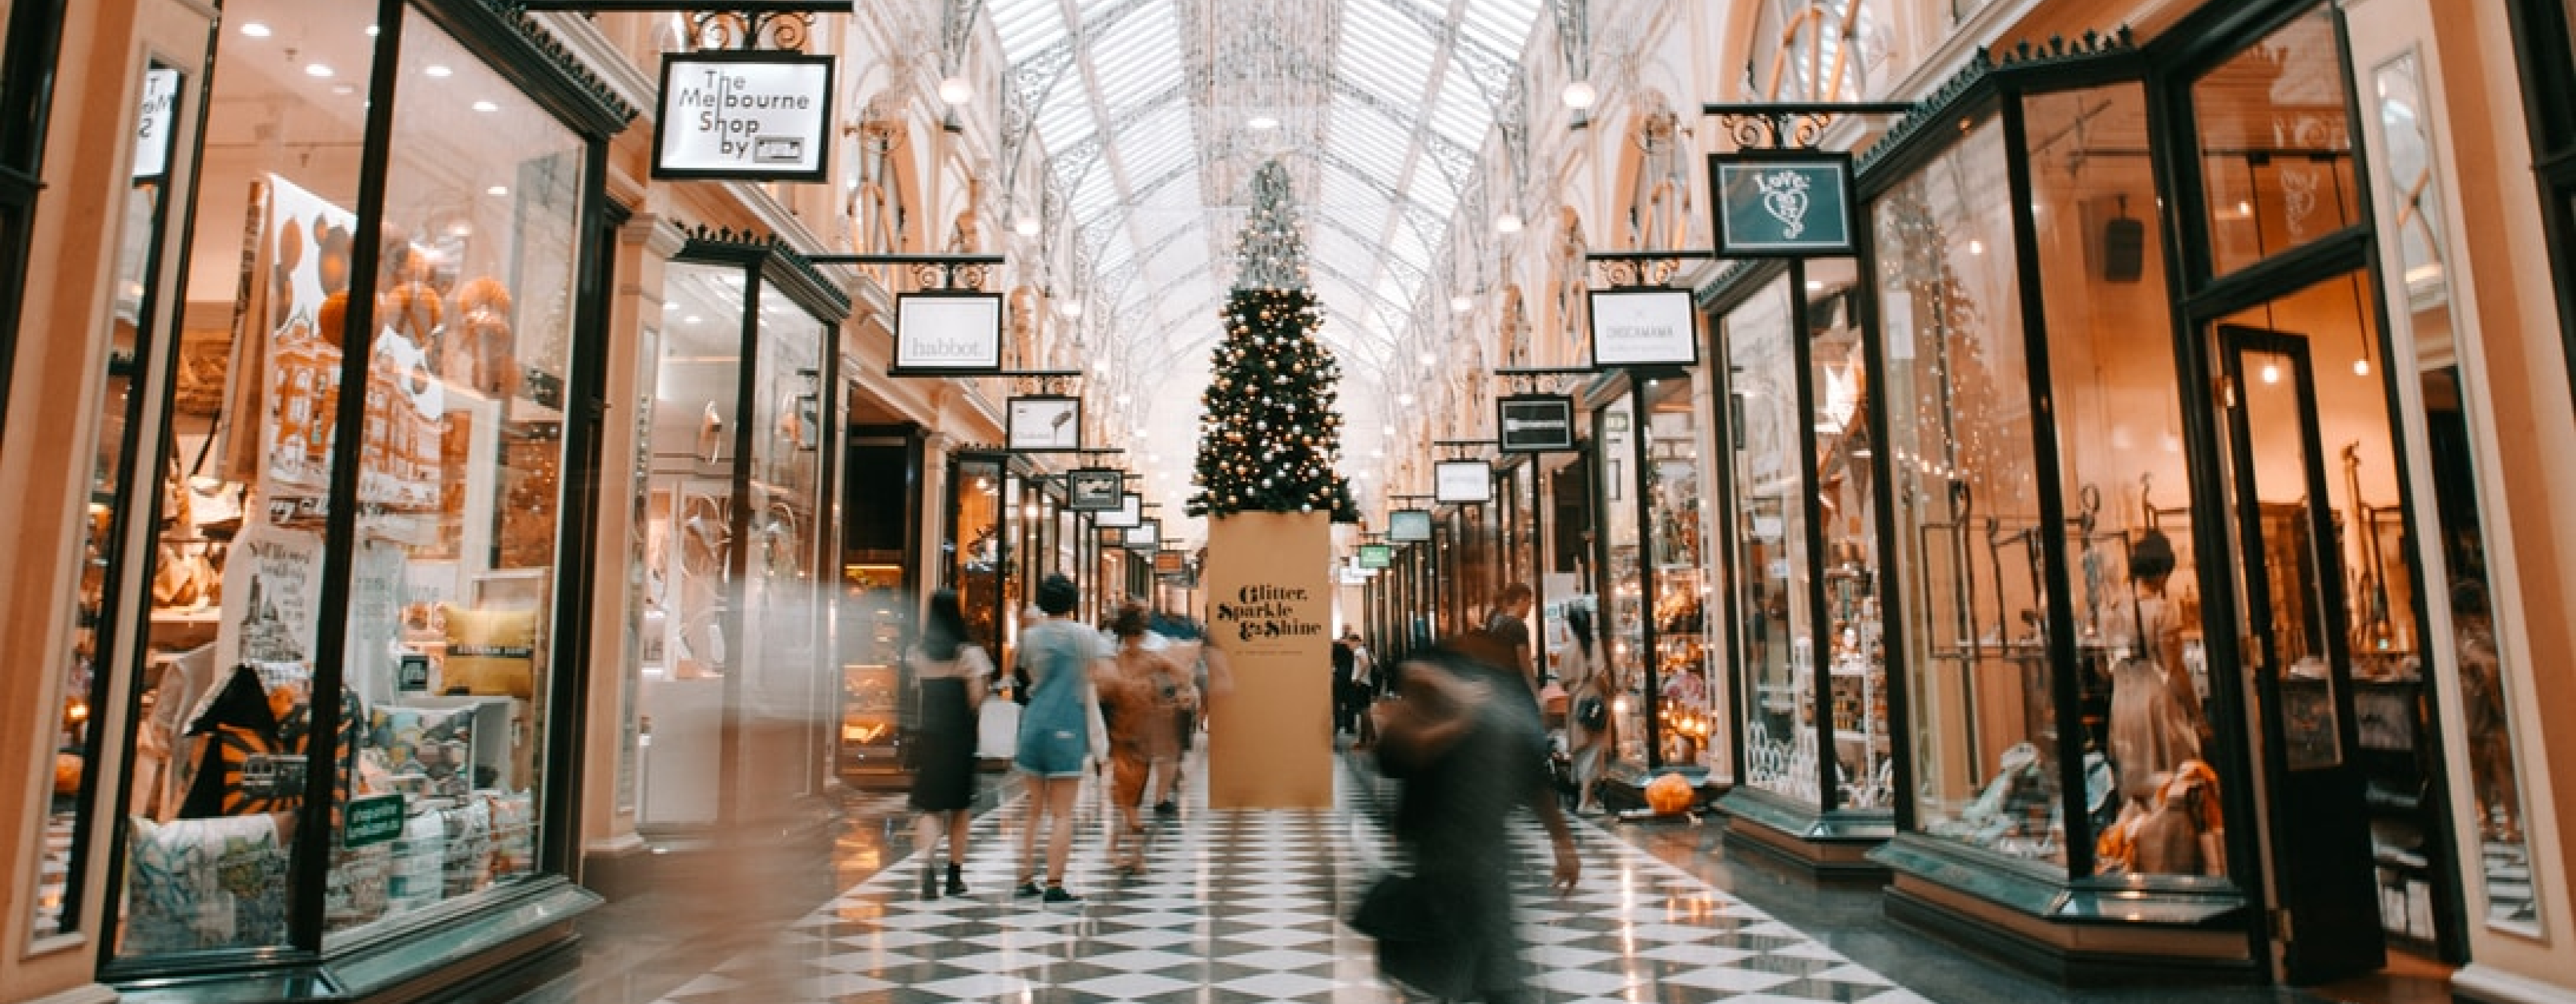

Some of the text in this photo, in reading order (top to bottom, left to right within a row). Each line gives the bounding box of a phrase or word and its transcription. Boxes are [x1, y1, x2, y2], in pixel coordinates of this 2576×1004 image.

[705, 70, 746, 90] The
[679, 87, 810, 109] Melbourne
[698, 110, 760, 137] Shop
[720, 139, 749, 158] by
[1217, 601, 1293, 623] Sparkle
[1264, 619, 1321, 639] Shine
